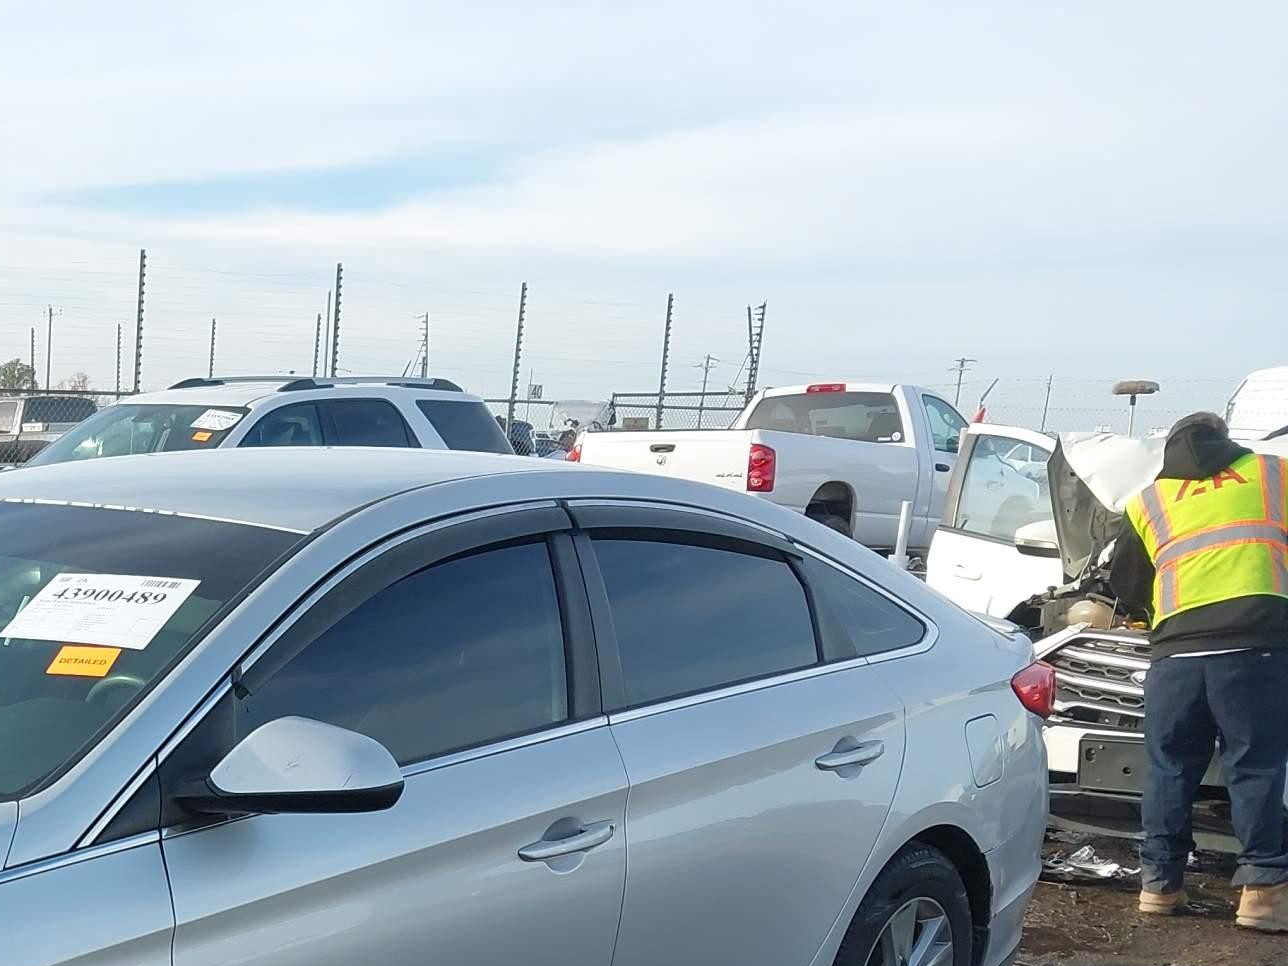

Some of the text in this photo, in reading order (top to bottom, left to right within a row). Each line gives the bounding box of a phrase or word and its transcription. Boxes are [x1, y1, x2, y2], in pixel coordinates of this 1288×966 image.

[531, 384, 543, 399] 40
[52, 587, 167, 604] 43900489
[58, 657, 107, 666] DETAILED
